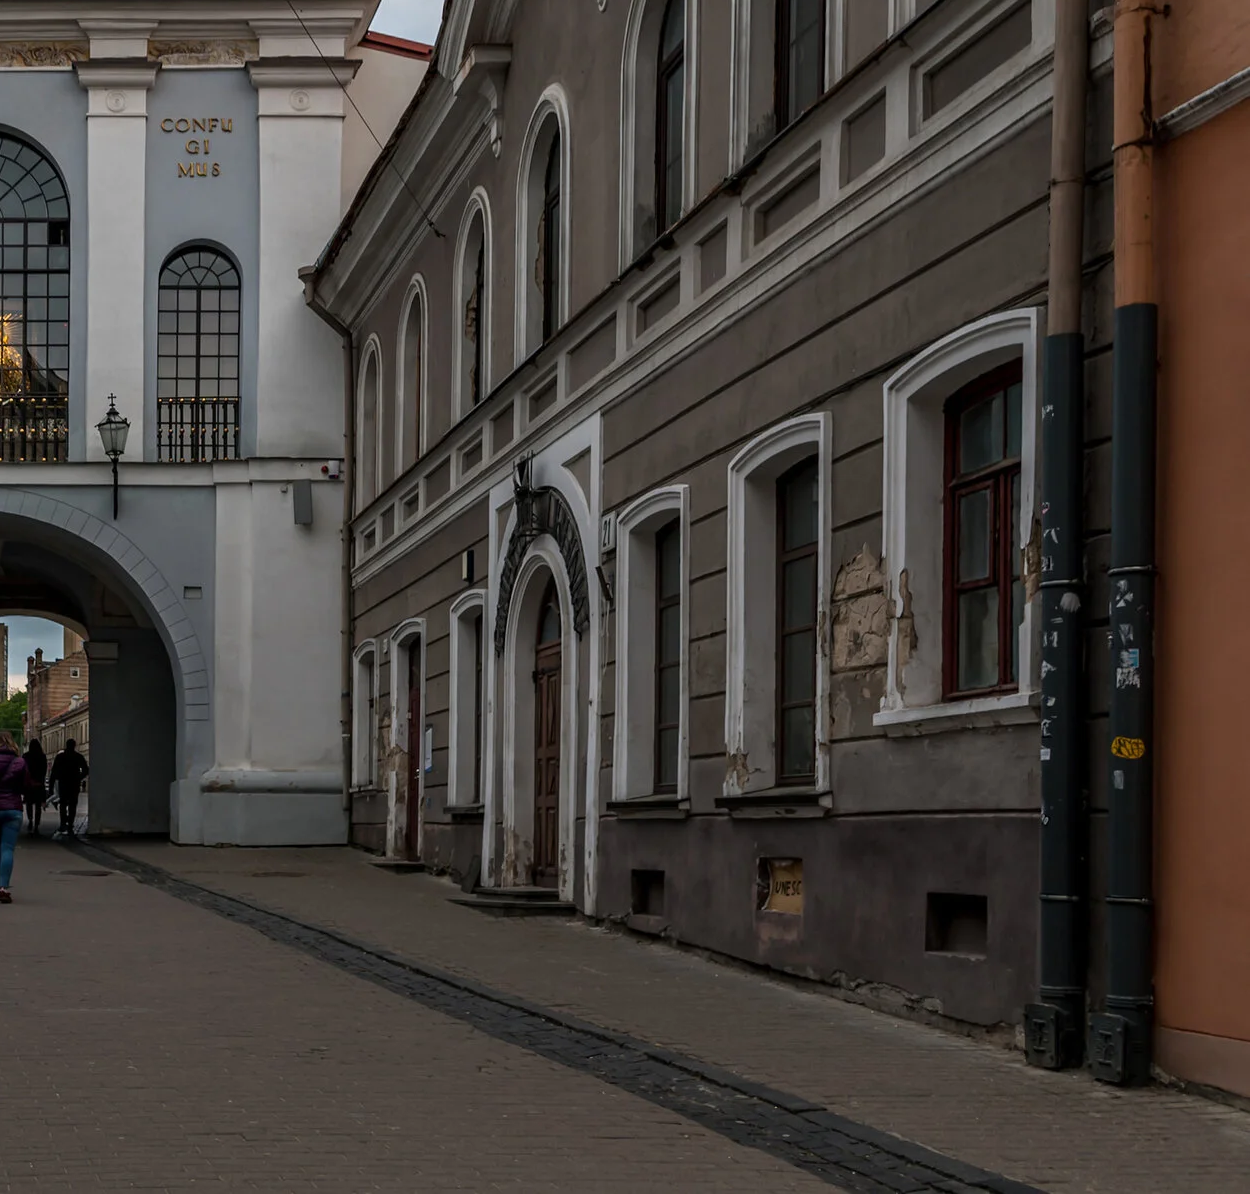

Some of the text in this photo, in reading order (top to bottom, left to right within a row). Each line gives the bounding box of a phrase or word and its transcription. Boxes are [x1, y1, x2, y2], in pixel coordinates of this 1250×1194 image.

[160, 118, 233, 133] CONFU
[185, 139, 210, 155] GI
[177, 162, 221, 178] MUS
[602, 517, 612, 548] 21
